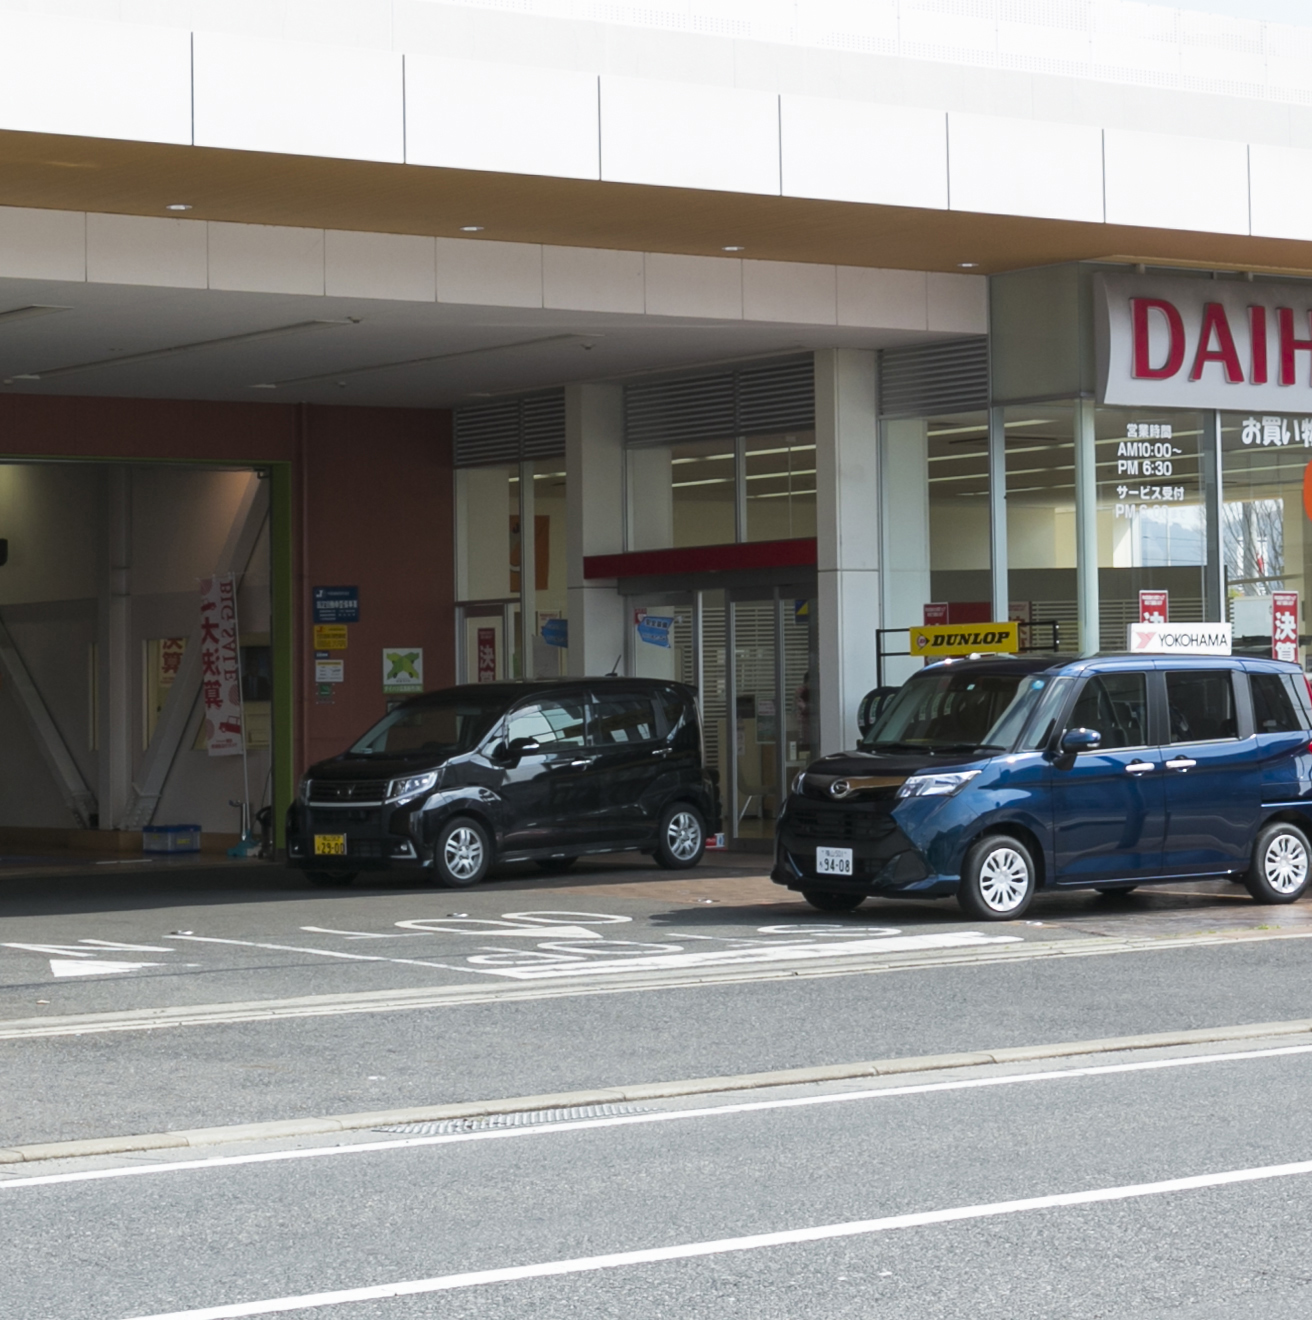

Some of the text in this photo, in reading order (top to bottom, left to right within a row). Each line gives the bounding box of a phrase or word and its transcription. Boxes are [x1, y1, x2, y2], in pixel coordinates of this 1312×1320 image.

[1126, 423, 1172, 439] 営業時間
[1118, 460, 1173, 476] PM 6:30
[1116, 485, 1185, 501] サービス受付
[931, 631, 1011, 647] DUNLOP
[1158, 633, 1229, 647] YOKOHAMA
[823, 857, 851, 873] 94-08
